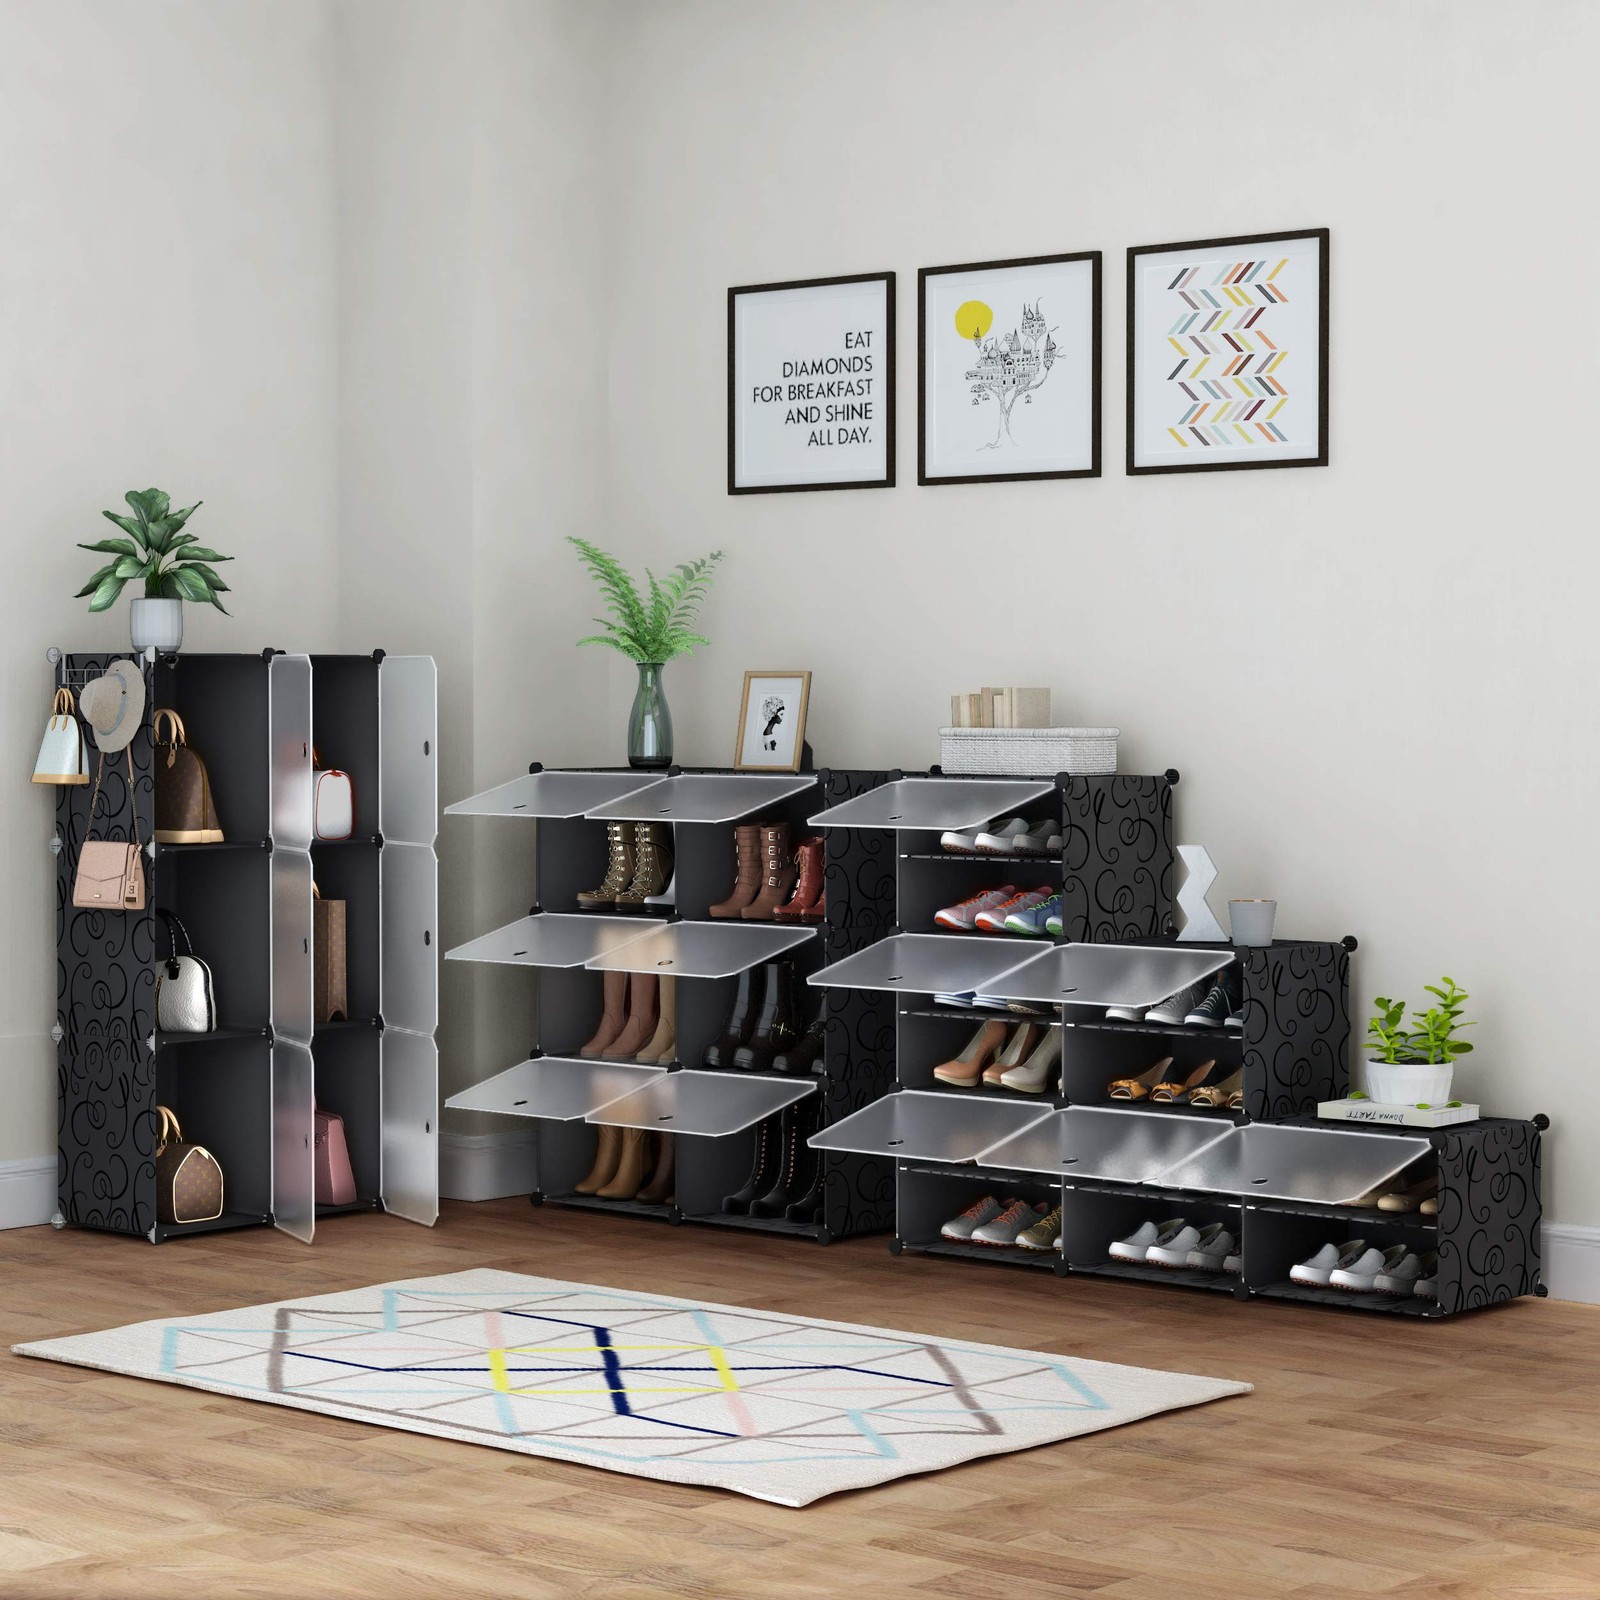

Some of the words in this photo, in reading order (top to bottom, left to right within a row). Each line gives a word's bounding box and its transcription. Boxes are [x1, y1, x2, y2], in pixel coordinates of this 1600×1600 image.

[845, 331, 873, 349] EAT
[782, 355, 873, 378] DIAMONDS
[753, 385, 783, 404] FOR
[788, 378, 873, 401] BREAKFAST
[785, 406, 821, 424] AND
[825, 402, 873, 422] SHINE
[807, 429, 833, 446] ALL
[838, 426, 872, 445] DAY.
[1346, 1110, 1376, 1120] TARTT
[1378, 1113, 1404, 1124] DONNA
